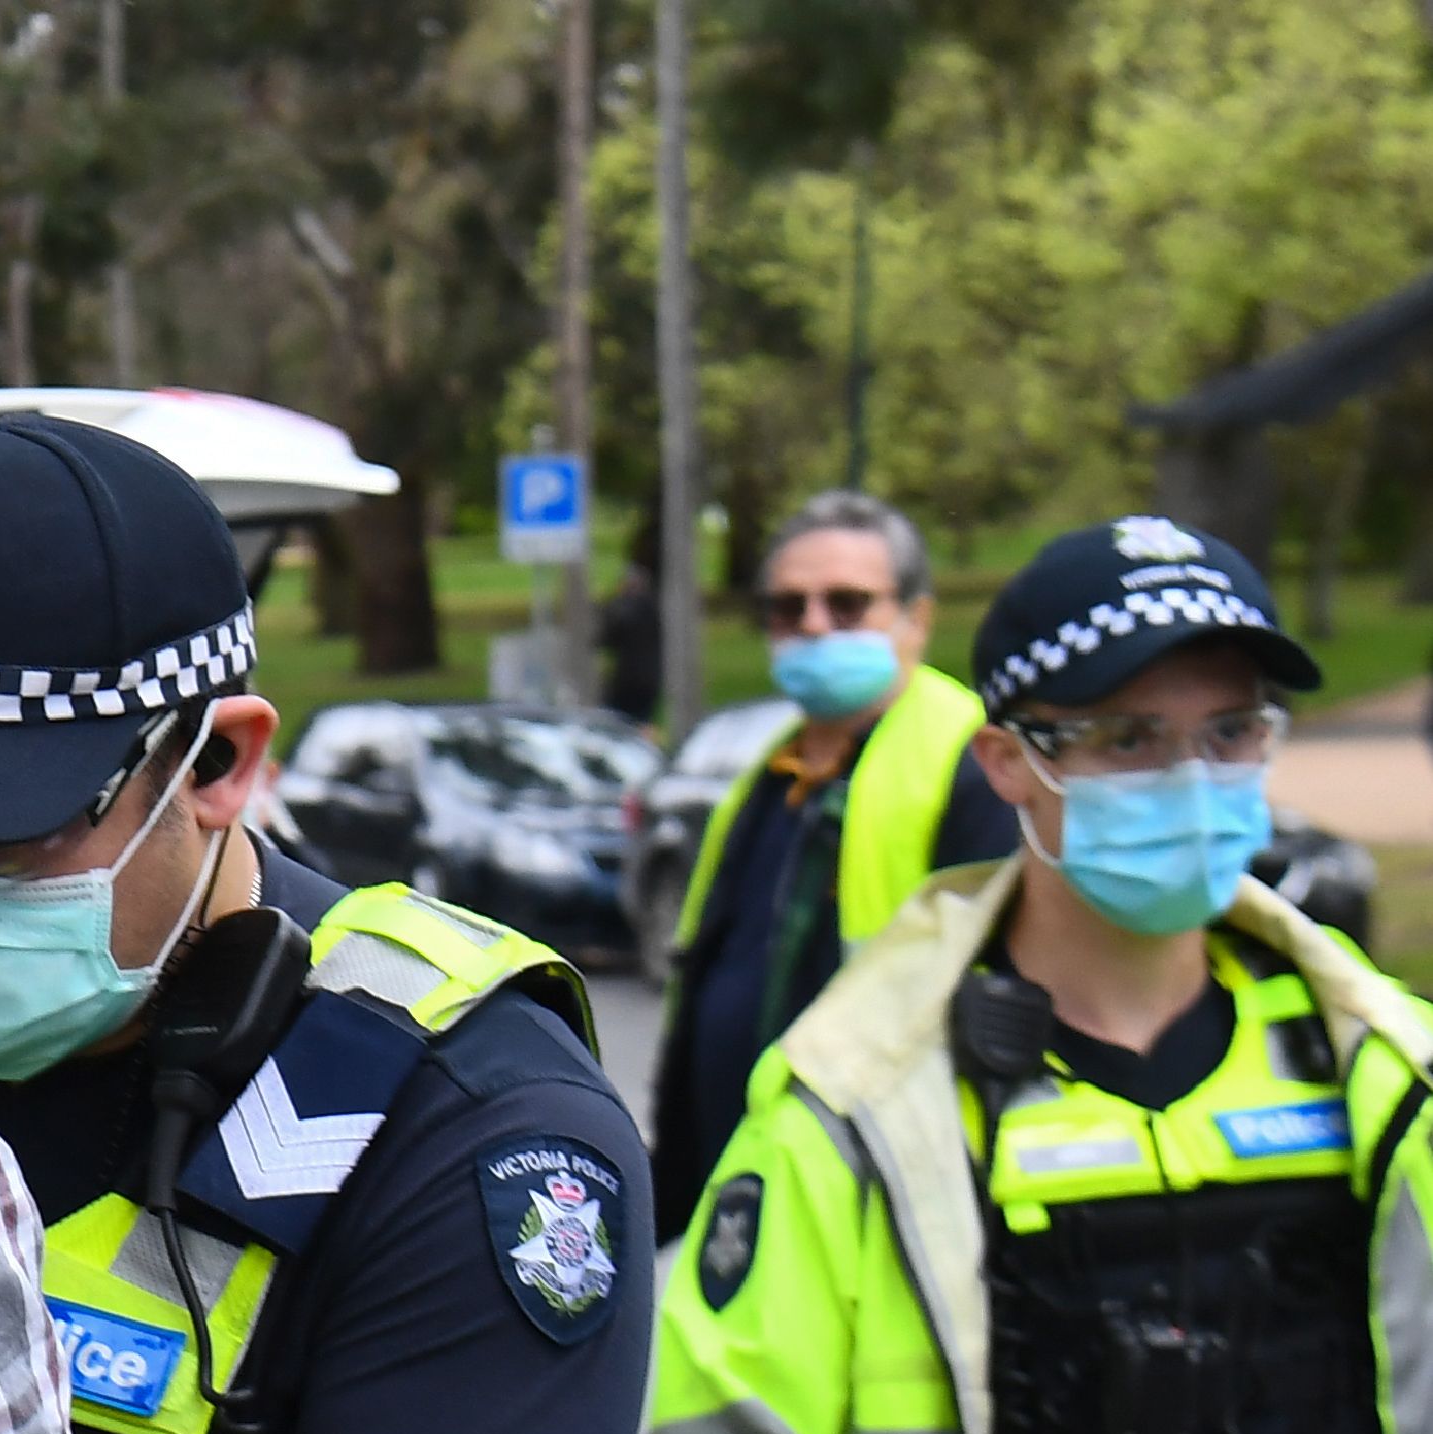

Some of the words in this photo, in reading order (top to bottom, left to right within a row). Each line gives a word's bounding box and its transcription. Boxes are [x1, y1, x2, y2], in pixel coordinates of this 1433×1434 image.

[522, 470, 564, 516] P
[488, 1150, 570, 1181] VICTORIA
[571, 1155, 621, 1196] POLICE
